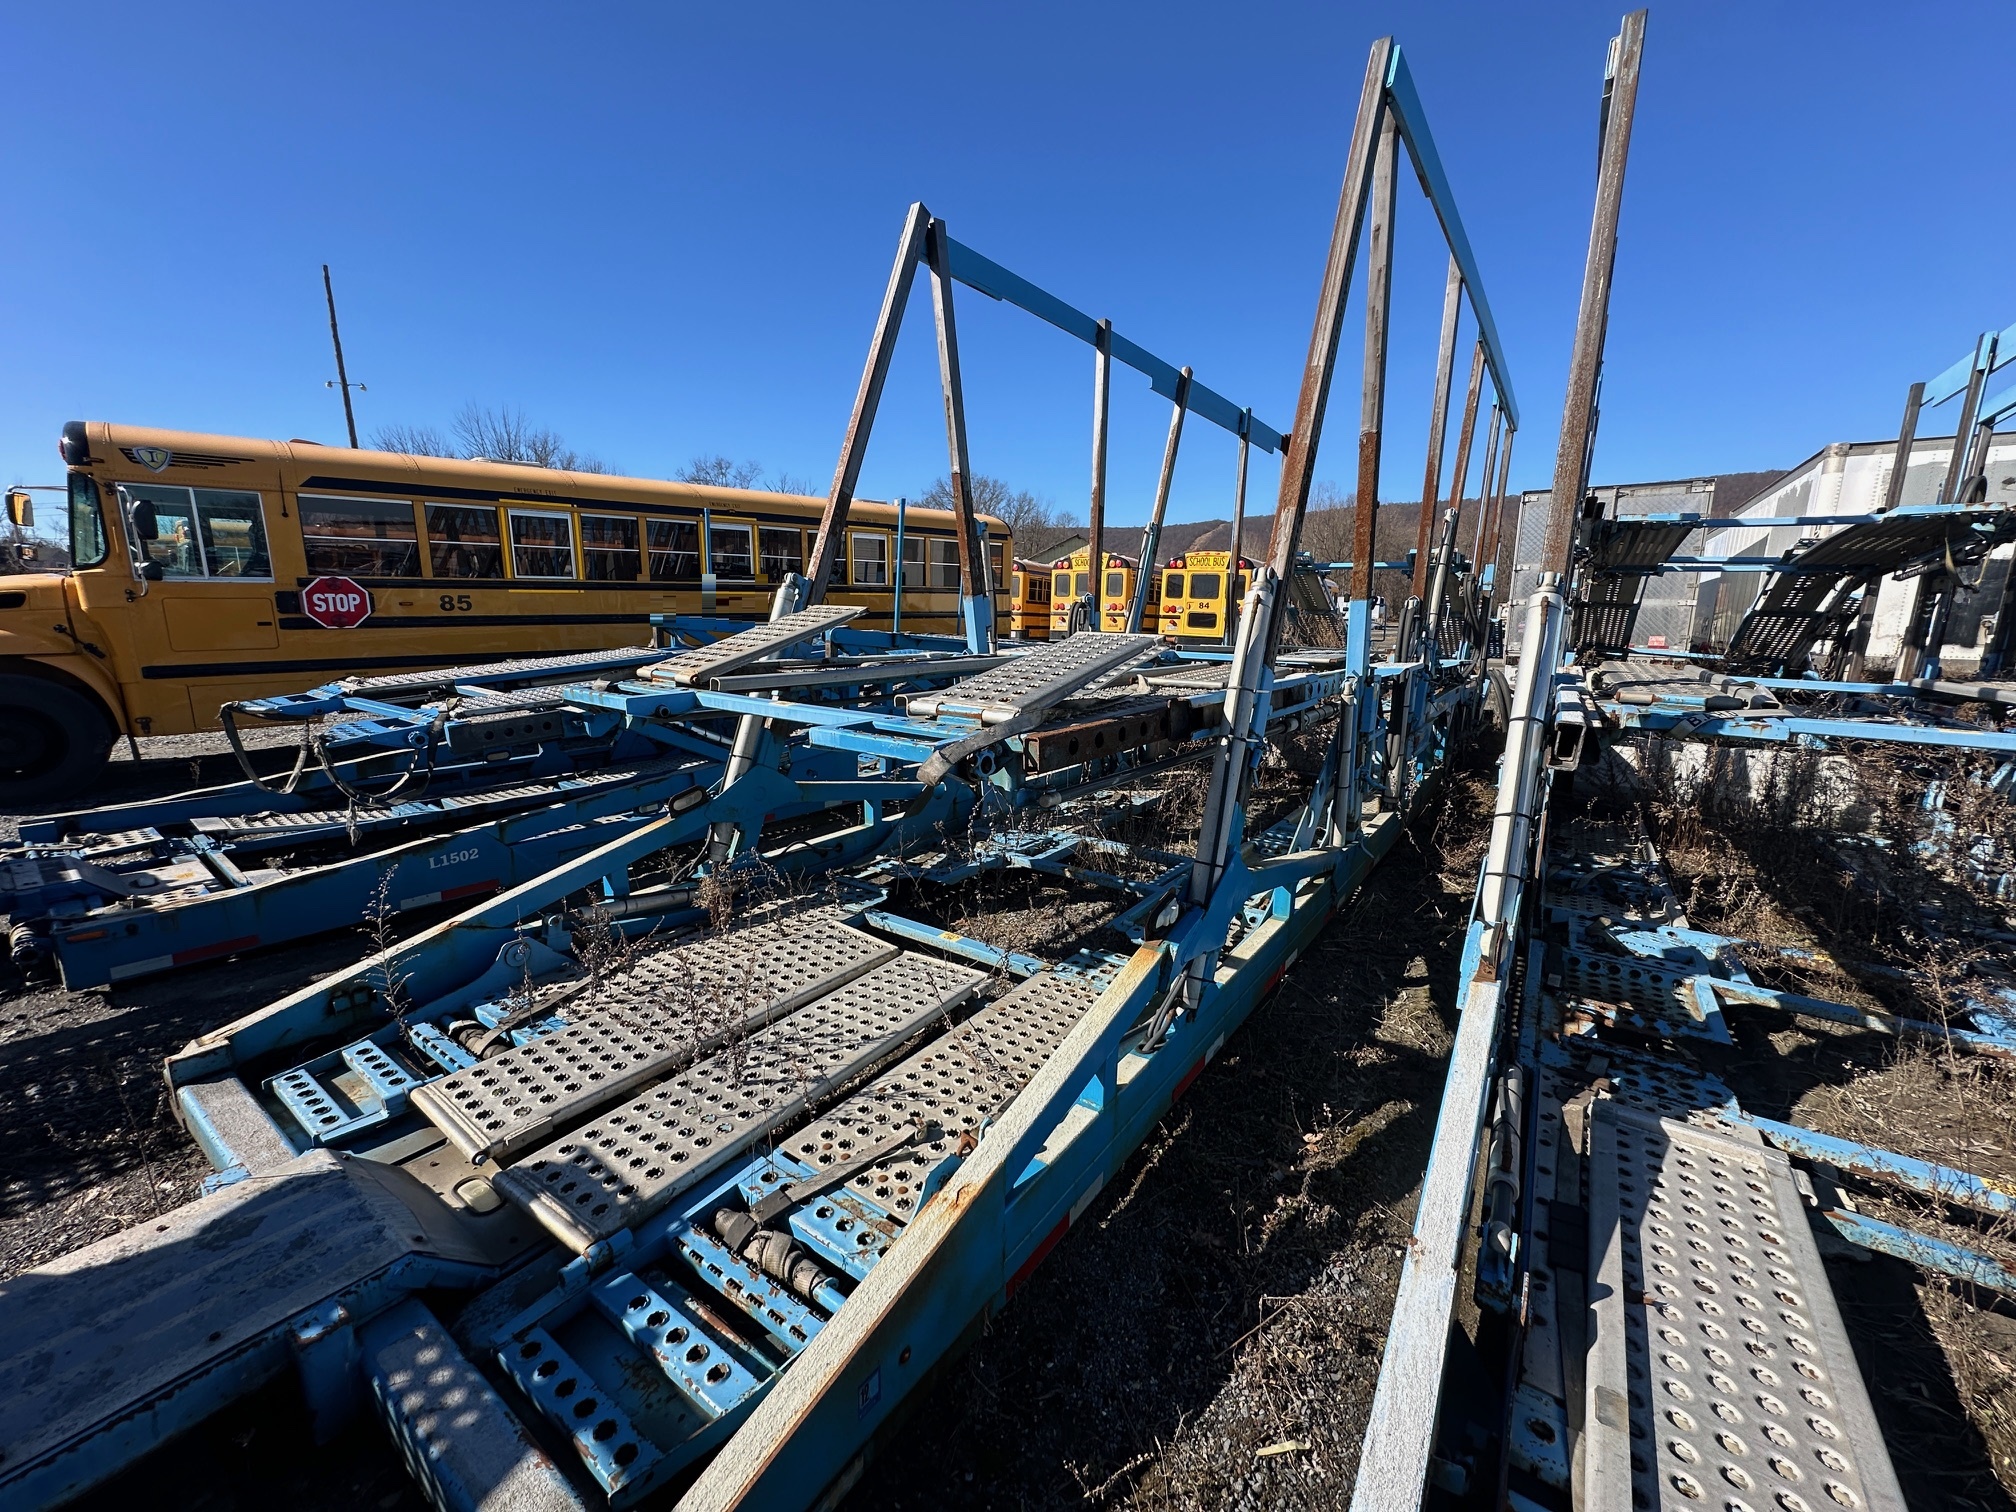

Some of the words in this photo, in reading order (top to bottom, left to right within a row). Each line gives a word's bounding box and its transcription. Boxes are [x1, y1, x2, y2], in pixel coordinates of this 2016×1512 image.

[1075, 559, 1089, 567] SCHO
[1189, 556, 1211, 567] SCHOOL
[1213, 556, 1226, 567] BUS
[312, 593, 361, 613] STOP
[439, 594, 473, 612] 85
[428, 848, 479, 869] L1502
